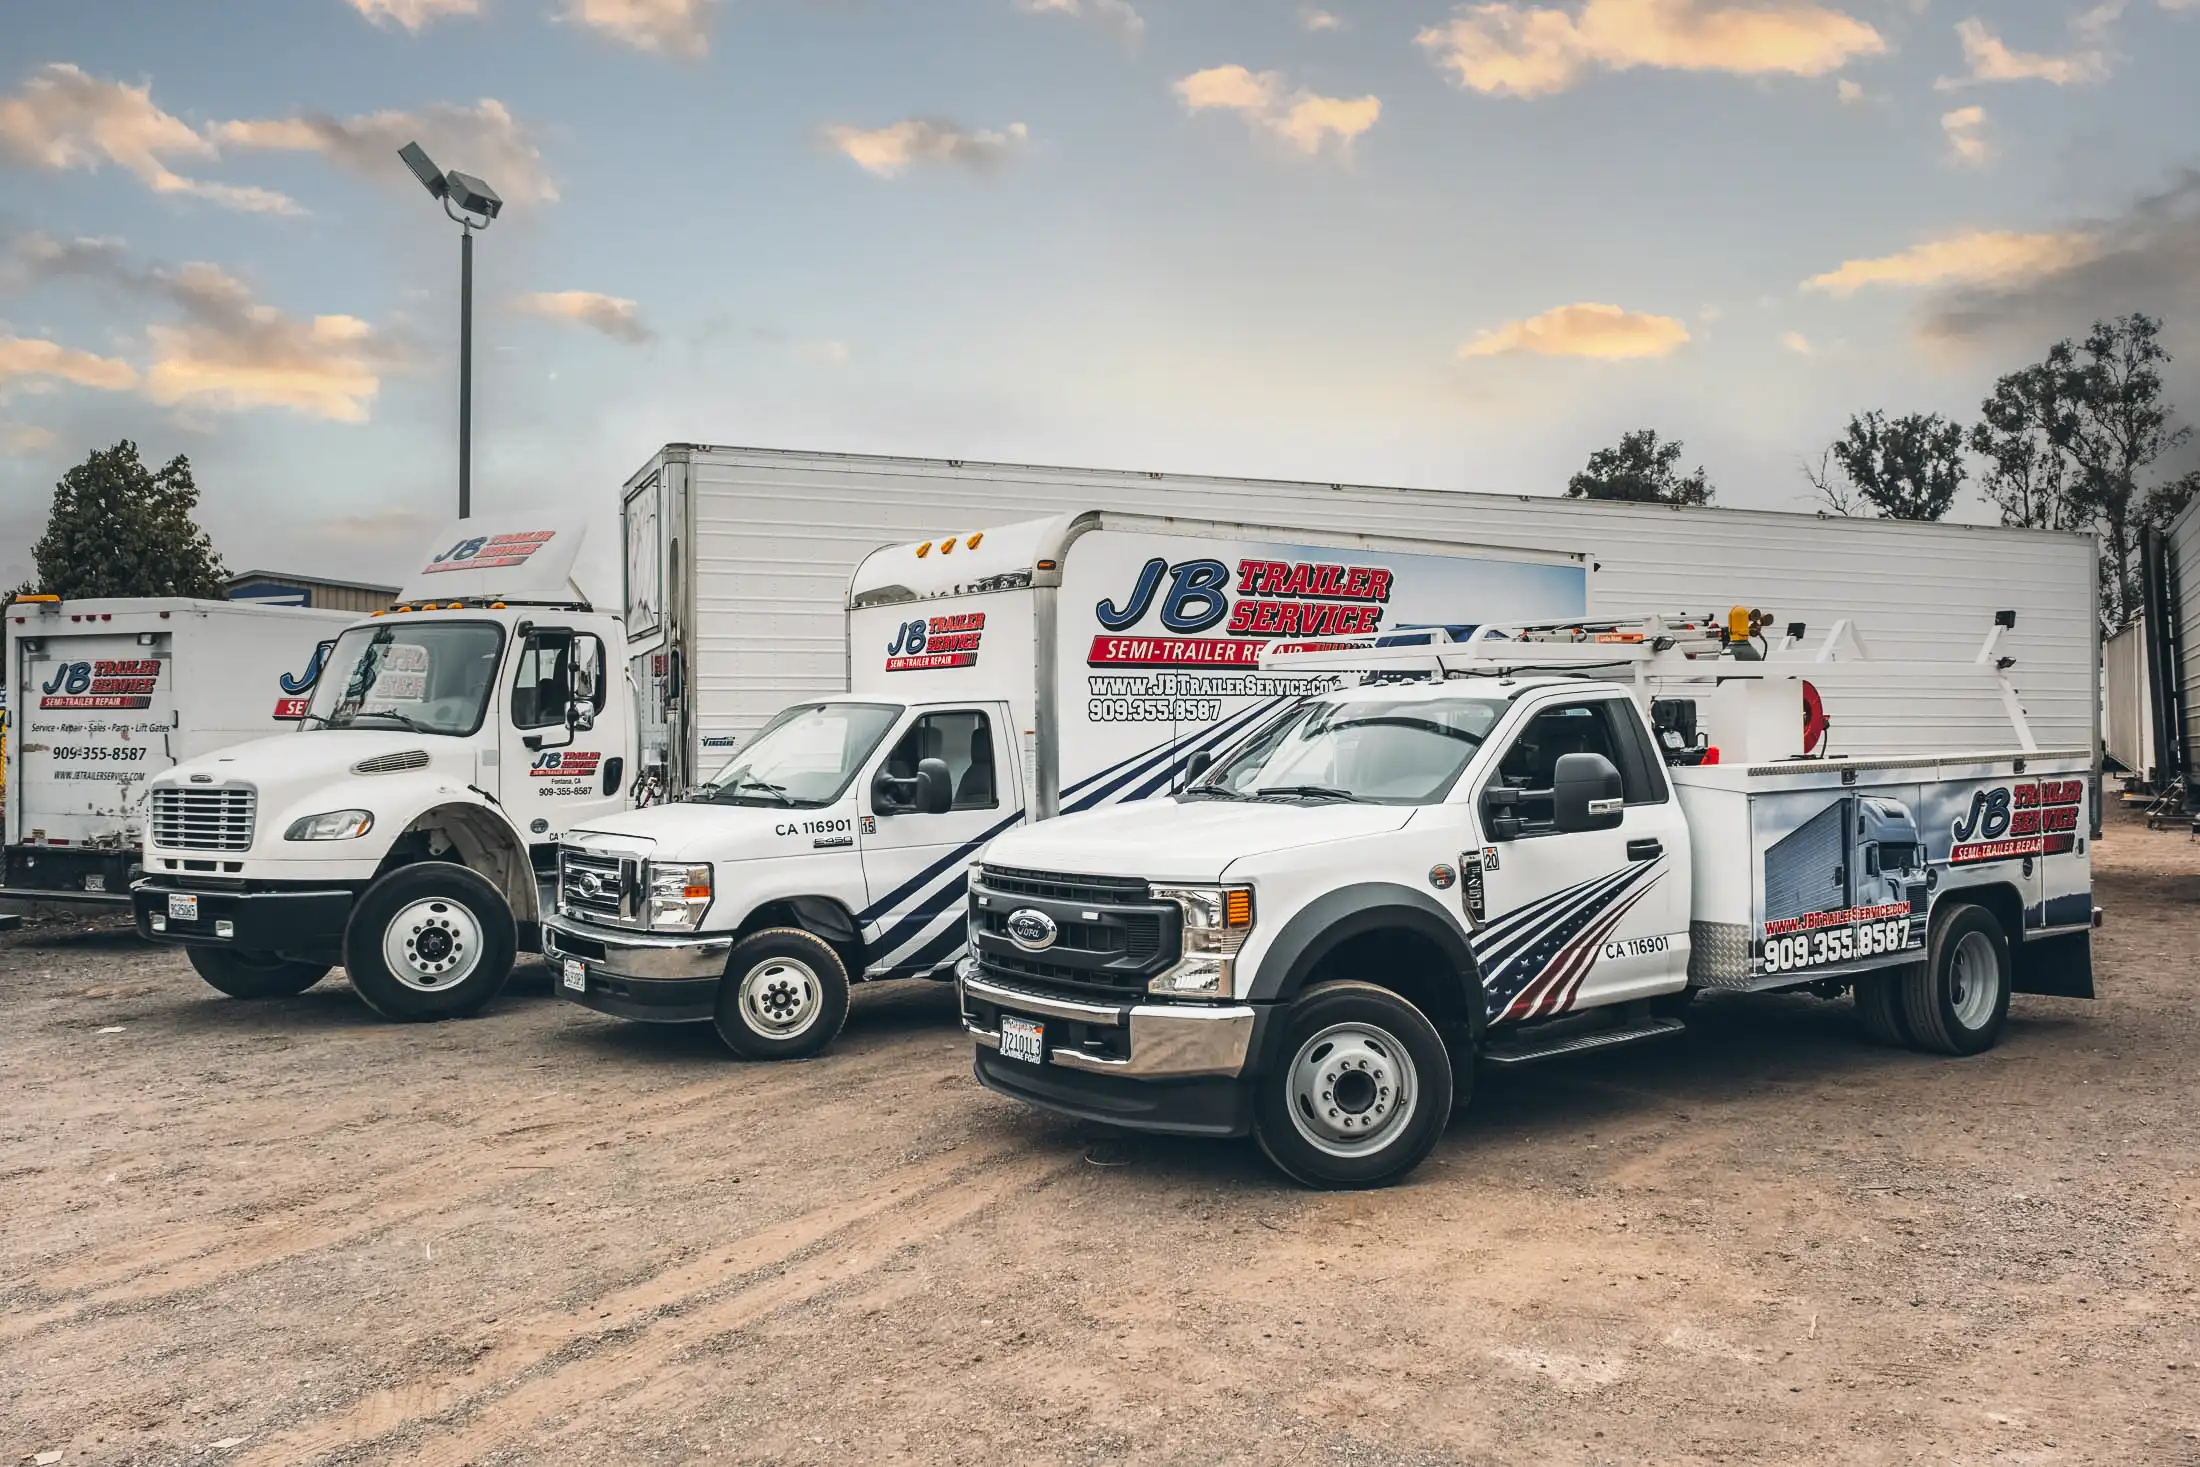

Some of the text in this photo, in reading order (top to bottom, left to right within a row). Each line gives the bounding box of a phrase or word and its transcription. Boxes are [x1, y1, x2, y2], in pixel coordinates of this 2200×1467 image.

[433, 537, 488, 563] JB
[1096, 557, 1394, 634] JB TRAILER
[1226, 601, 1384, 637] SERVICE
[887, 613, 985, 656] JB TRAILER
[926, 632, 981, 654] SERVICE
[1106, 640, 1236, 661] SEMI-TRAILER
[890, 656, 952, 668] SEMI-TRAILER REPAIR
[42, 660, 161, 695] JB TRAILER
[89, 678, 156, 694] SERVICE
[45, 697, 121, 706] SEMI-TRAILER REPAIR
[1088, 699, 1221, 721] 909.355.8587
[31, 723, 170, 733] Service Repair Sales Parts Lift Gates
[53, 746, 147, 760] 909-355-8587
[531, 752, 561, 769] JB
[54, 771, 146, 781] WWW.JBTRAILERSERVICE.COM
[539, 787, 592, 796] 909-355-8587
[1953, 780, 2083, 842] JB TRAILER
[775, 819, 851, 836] CA 116901
[862, 822, 874, 833] 15
[2009, 806, 2079, 837] SERVICE
[549, 832, 559, 841] CA
[1958, 842, 2014, 860] SEMI-TRAILER
[1485, 854, 1498, 869] 20
[1018, 919, 1040, 937] Ford
[1606, 936, 1668, 959] CA 116901
[1764, 919, 1910, 973] 909.355.8587
